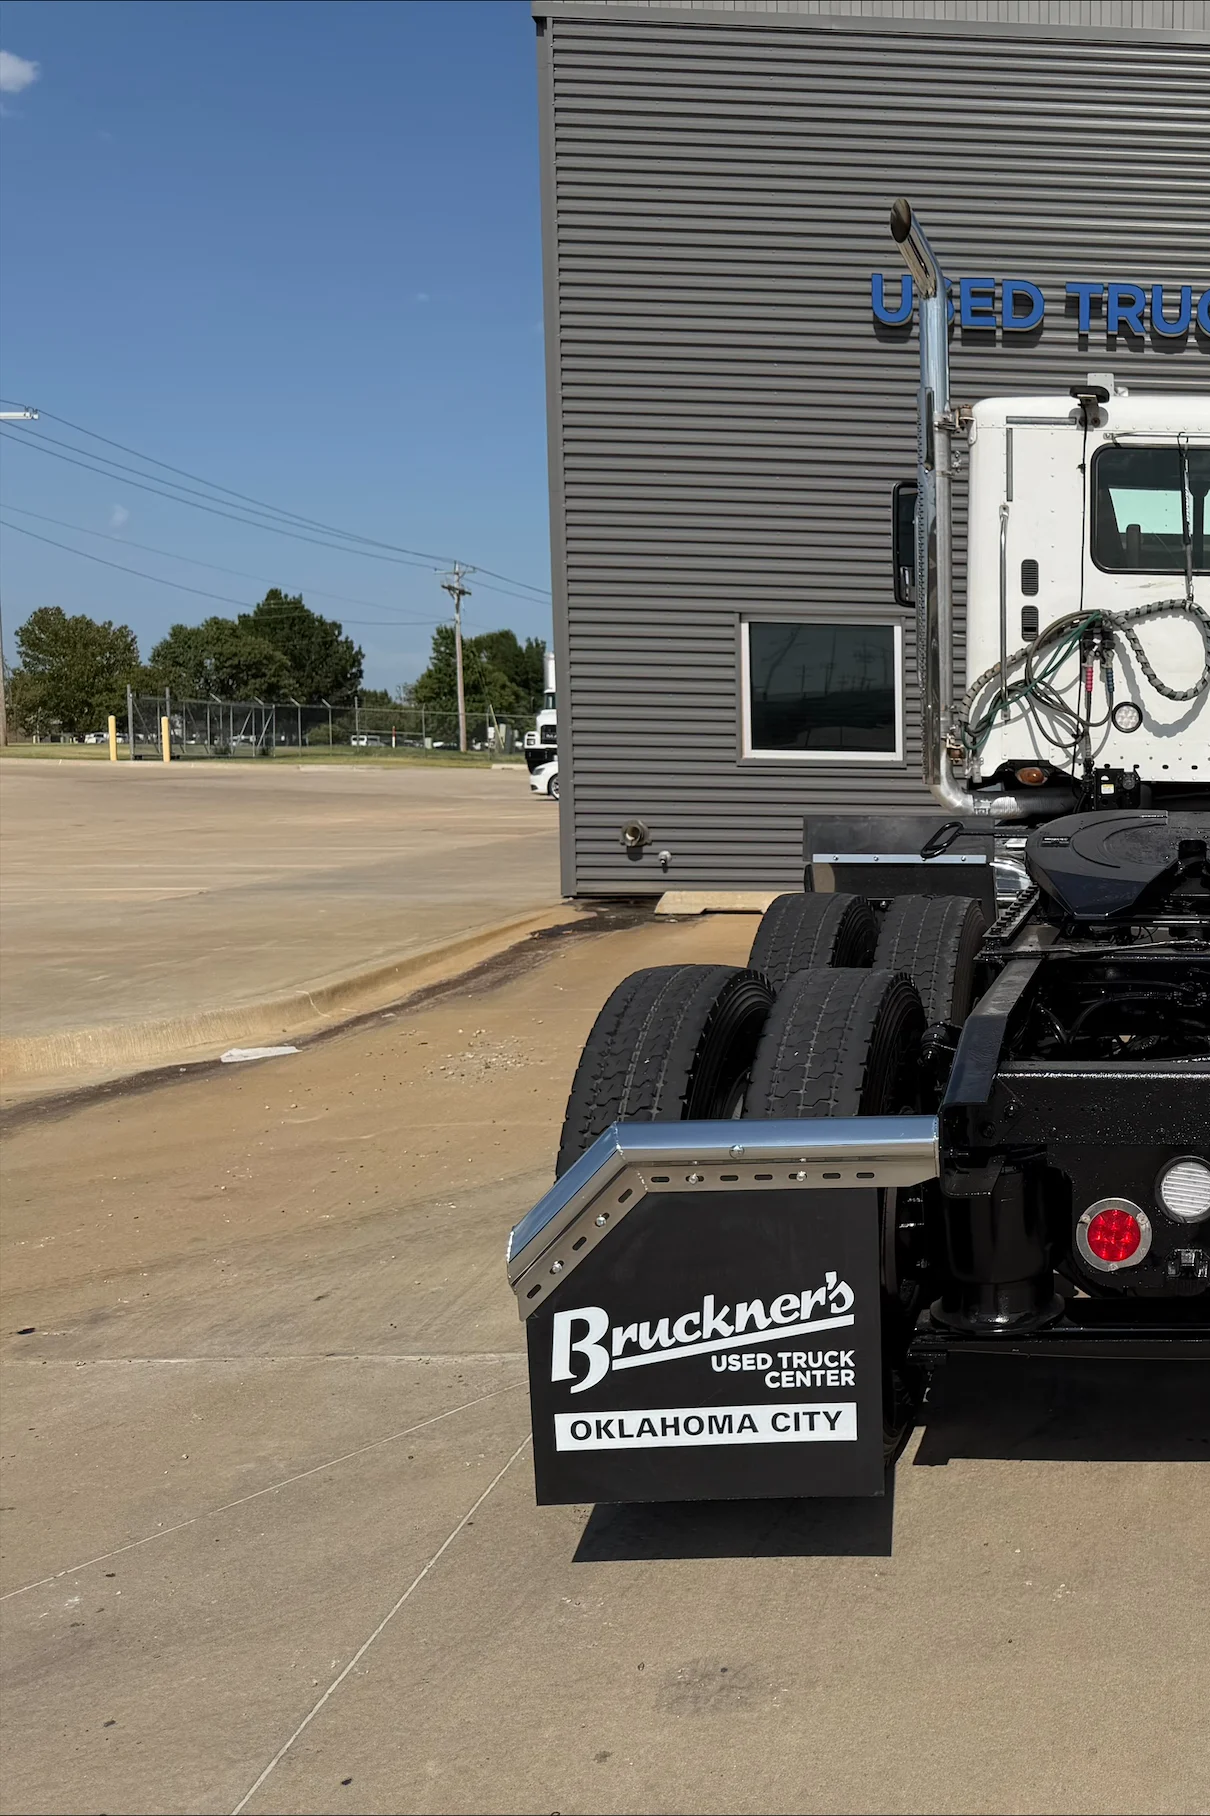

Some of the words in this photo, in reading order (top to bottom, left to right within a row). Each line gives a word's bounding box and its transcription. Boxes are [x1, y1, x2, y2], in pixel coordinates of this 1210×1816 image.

[871, 273, 1045, 331] UED
[551, 1271, 855, 1394] Bruckner's
[711, 1353, 773, 1372] USED
[777, 1350, 856, 1369] TRUCK
[765, 1369, 856, 1388] CENTER
[570, 1413, 759, 1441] OKLAHOMA
[771, 1410, 843, 1432] CITY
